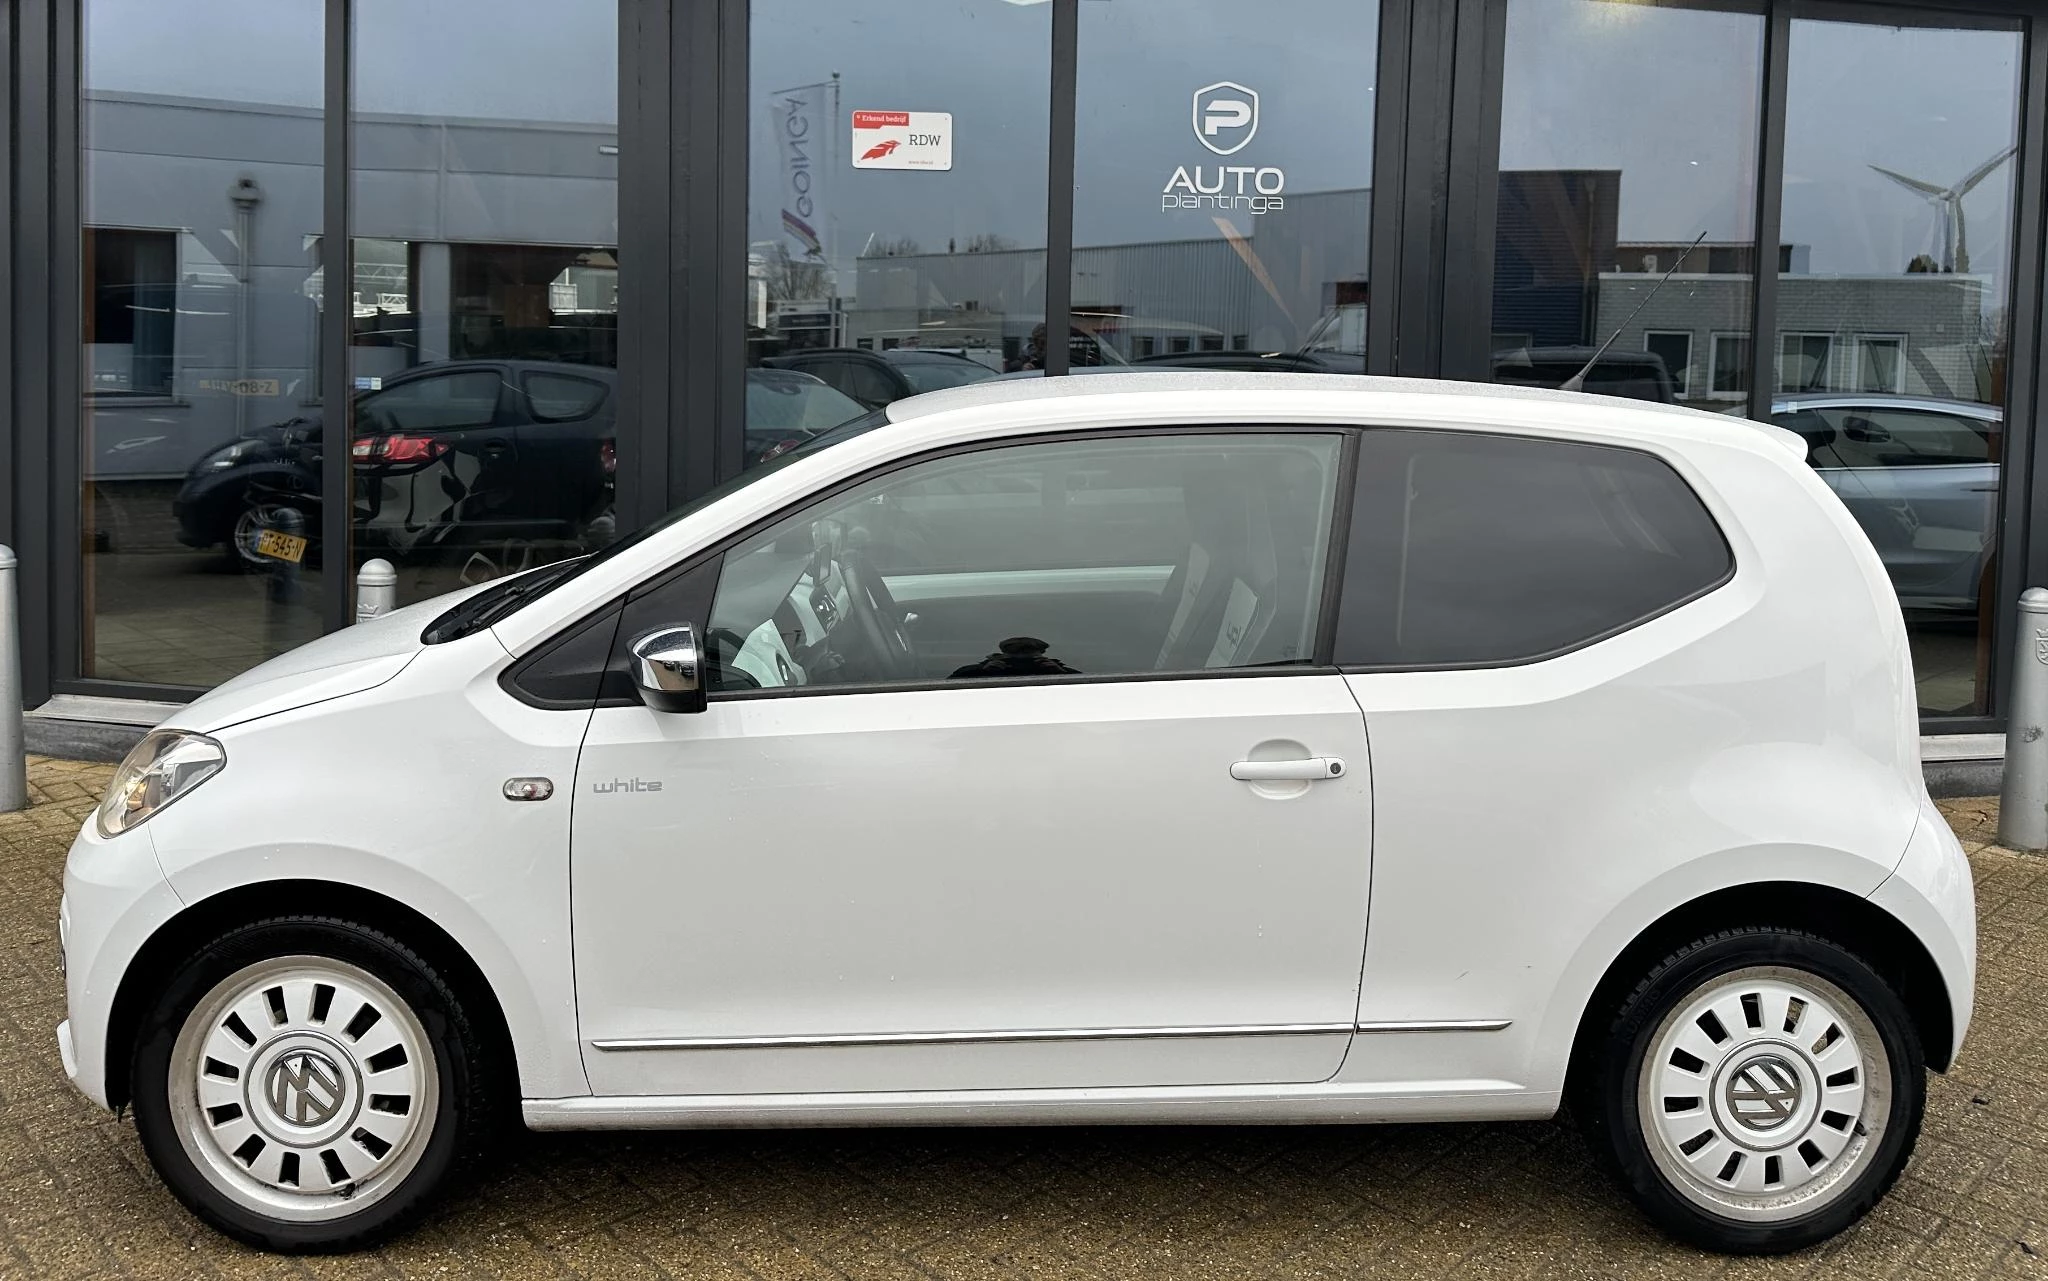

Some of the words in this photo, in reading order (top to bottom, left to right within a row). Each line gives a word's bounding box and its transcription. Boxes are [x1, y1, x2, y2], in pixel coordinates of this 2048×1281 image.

[862, 114, 885, 122] Erkend
[886, 115, 908, 125] bedrijf
[1205, 100, 1252, 135] P
[908, 134, 942, 147] RDW
[1163, 166, 1285, 195] AUTO
[1162, 193, 1284, 215] plantinga
[593, 777, 663, 793] white
